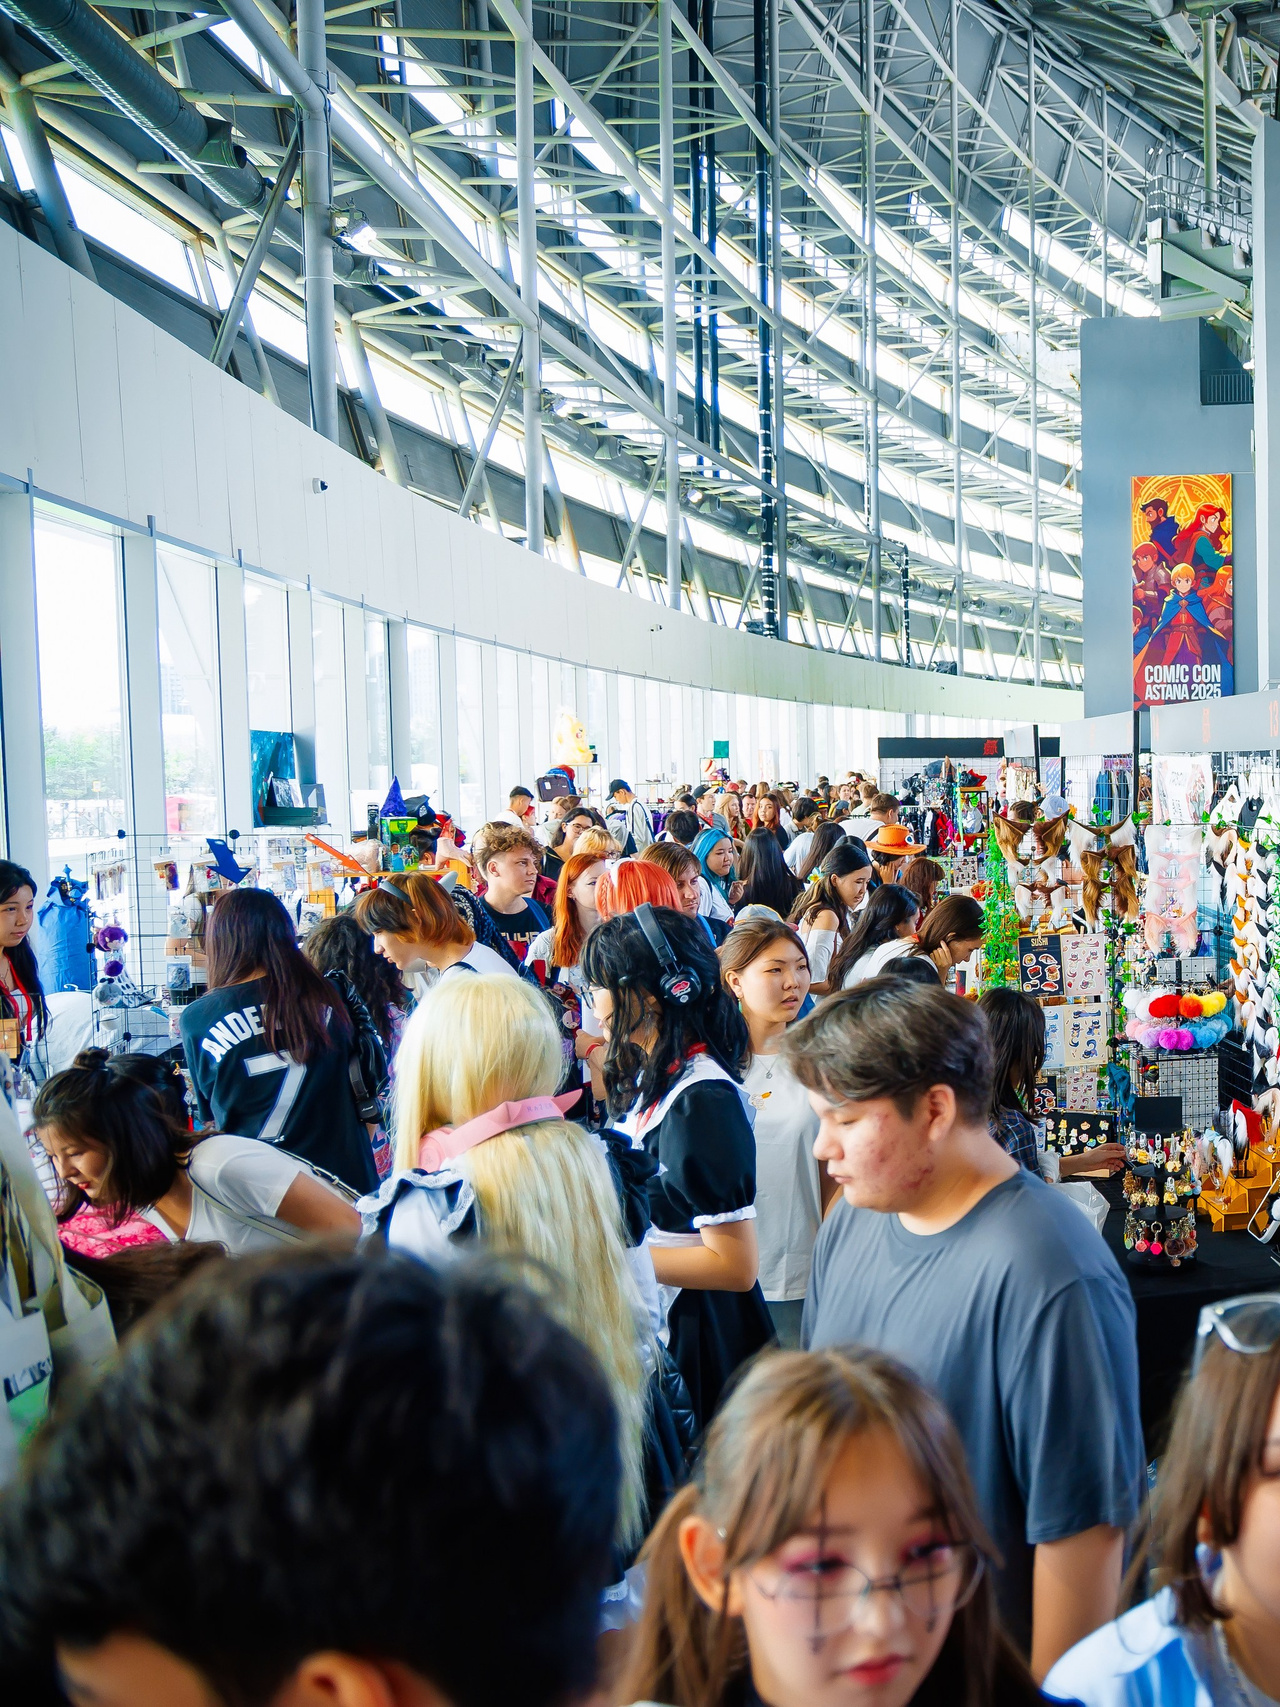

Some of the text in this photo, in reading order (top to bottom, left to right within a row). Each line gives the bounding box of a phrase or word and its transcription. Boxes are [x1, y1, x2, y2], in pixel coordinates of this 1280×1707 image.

[1144, 684, 1221, 700] ASTANA 2025
[1192, 664, 1221, 683] CON
[1268, 700, 1279, 737] 13
[201, 1003, 282, 1063] ANDE
[243, 1049, 307, 1139] 7
